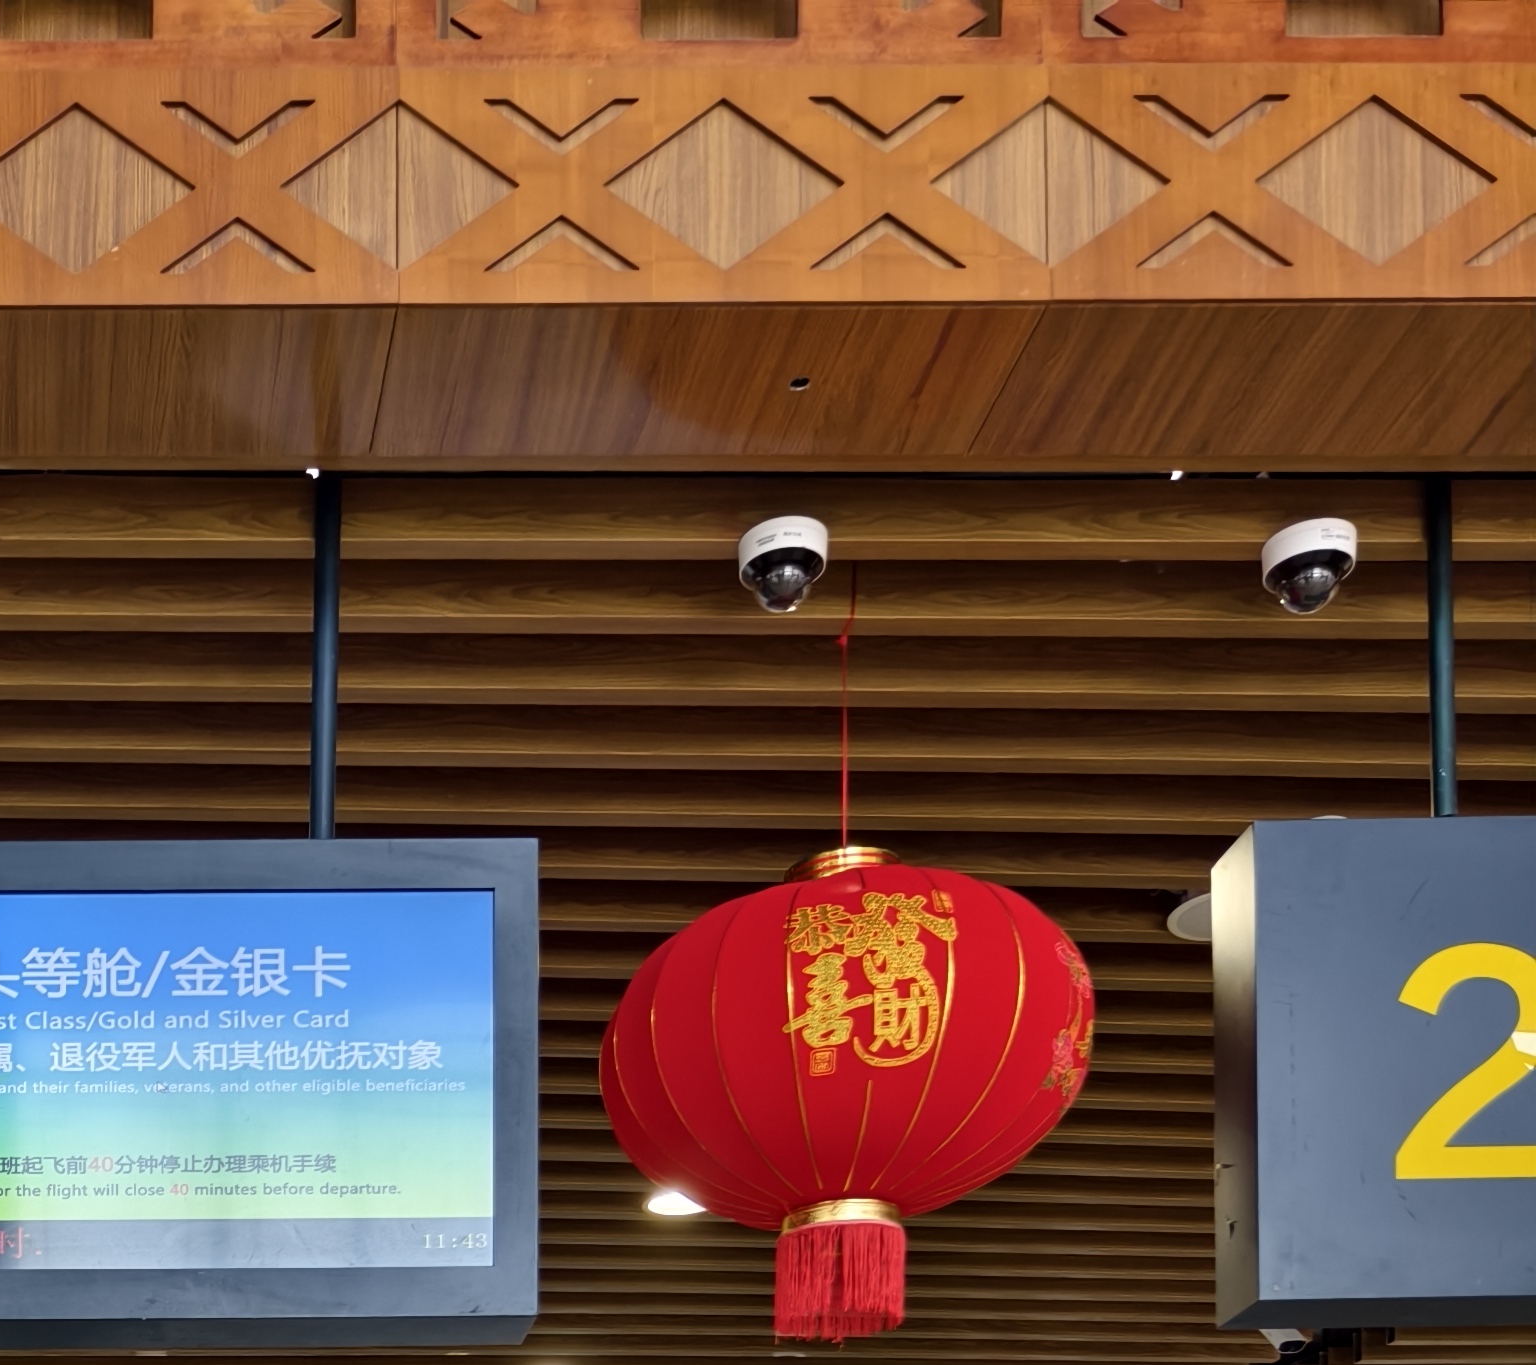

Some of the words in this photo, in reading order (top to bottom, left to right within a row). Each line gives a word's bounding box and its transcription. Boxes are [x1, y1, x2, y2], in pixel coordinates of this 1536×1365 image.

[25, 1010, 155, 1032] Class/Gold
[164, 1009, 209, 1029] and
[218, 1009, 286, 1030] Silver
[293, 1008, 350, 1028] Card
[1394, 942, 1536, 1180] 2
[32, 1080, 71, 1094] their
[74, 1080, 139, 1095] families,
[220, 1079, 249, 1093] and
[254, 1079, 297, 1093] other
[302, 1079, 361, 1096] eligible
[365, 1077, 467, 1093] beneficiaries
[15, 1183, 42, 1197] the
[45, 1183, 89, 1200] flight
[92, 1183, 120, 1197] will
[124, 1182, 166, 1197] close
[168, 1183, 190, 1197] 40
[193, 1182, 258, 1197] minutes
[262, 1182, 315, 1197] before
[318, 1182, 403, 1199] departure.
[422, 1233, 488, 1250] 11:43
